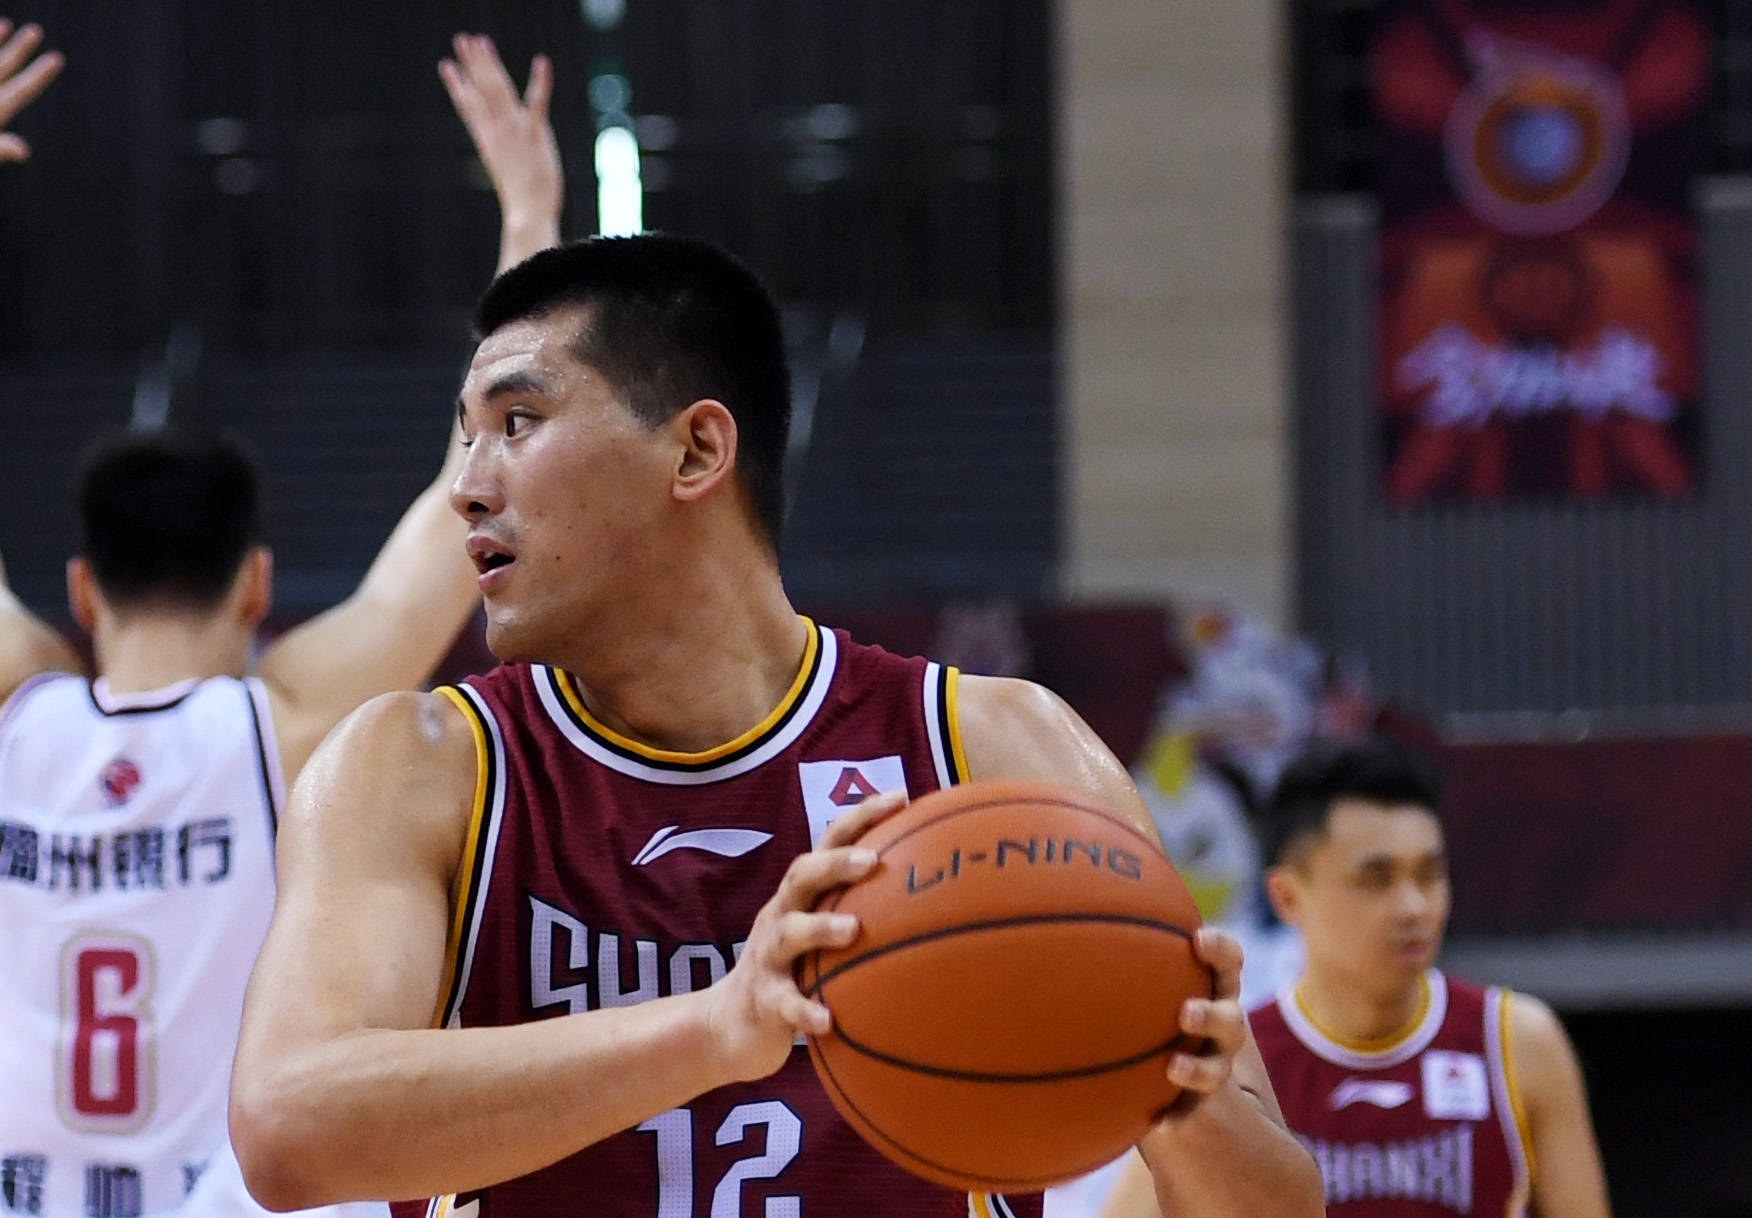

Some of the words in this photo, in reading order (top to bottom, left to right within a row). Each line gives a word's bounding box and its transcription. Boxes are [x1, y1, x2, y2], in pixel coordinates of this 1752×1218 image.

[907, 838, 1141, 894] LI-NING
[70, 944, 145, 1122] 6
[1297, 1126, 1473, 1214] HANXI
